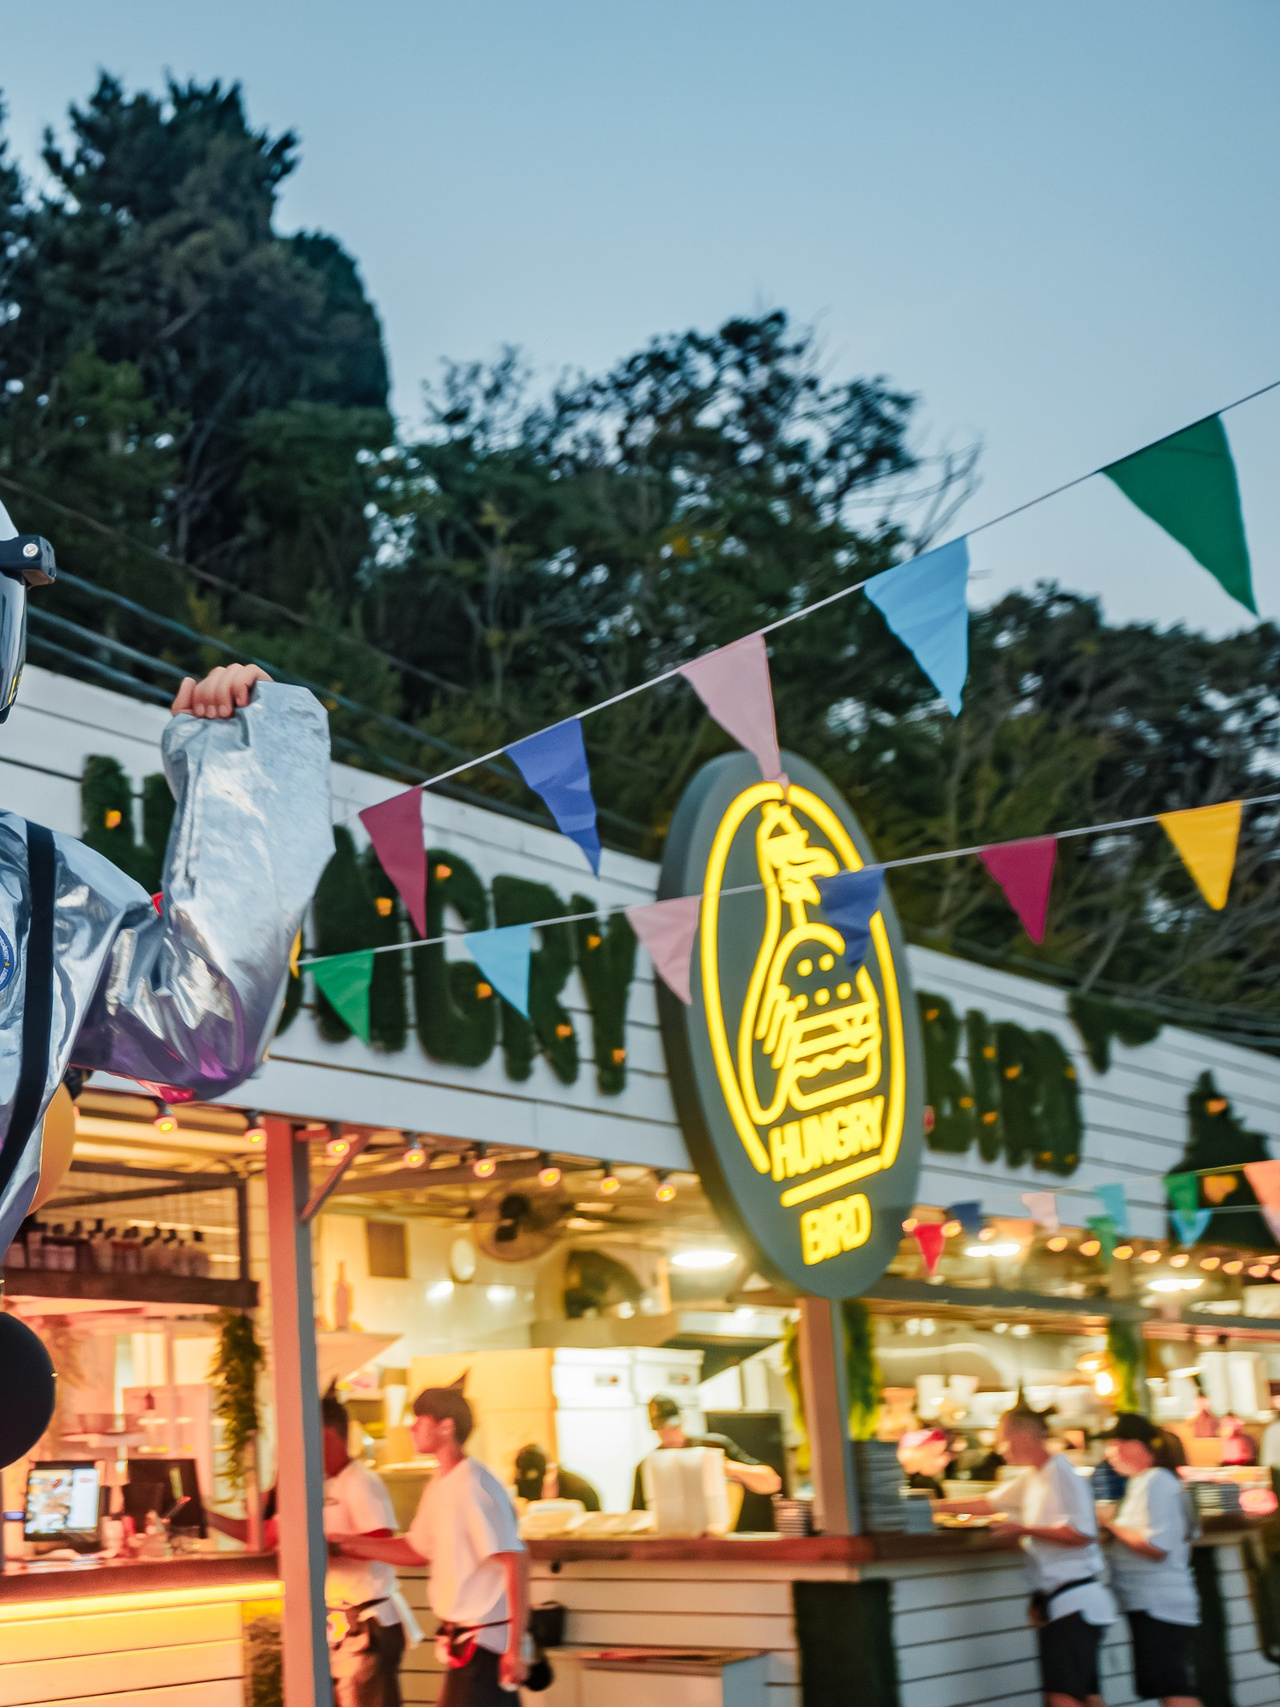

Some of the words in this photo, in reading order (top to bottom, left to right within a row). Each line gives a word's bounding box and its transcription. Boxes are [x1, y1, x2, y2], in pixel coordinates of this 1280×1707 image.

[916, 989, 1084, 1178] BIRD
[768, 1095, 884, 1182] HUNGRY
[800, 1193, 872, 1266] BIRD
